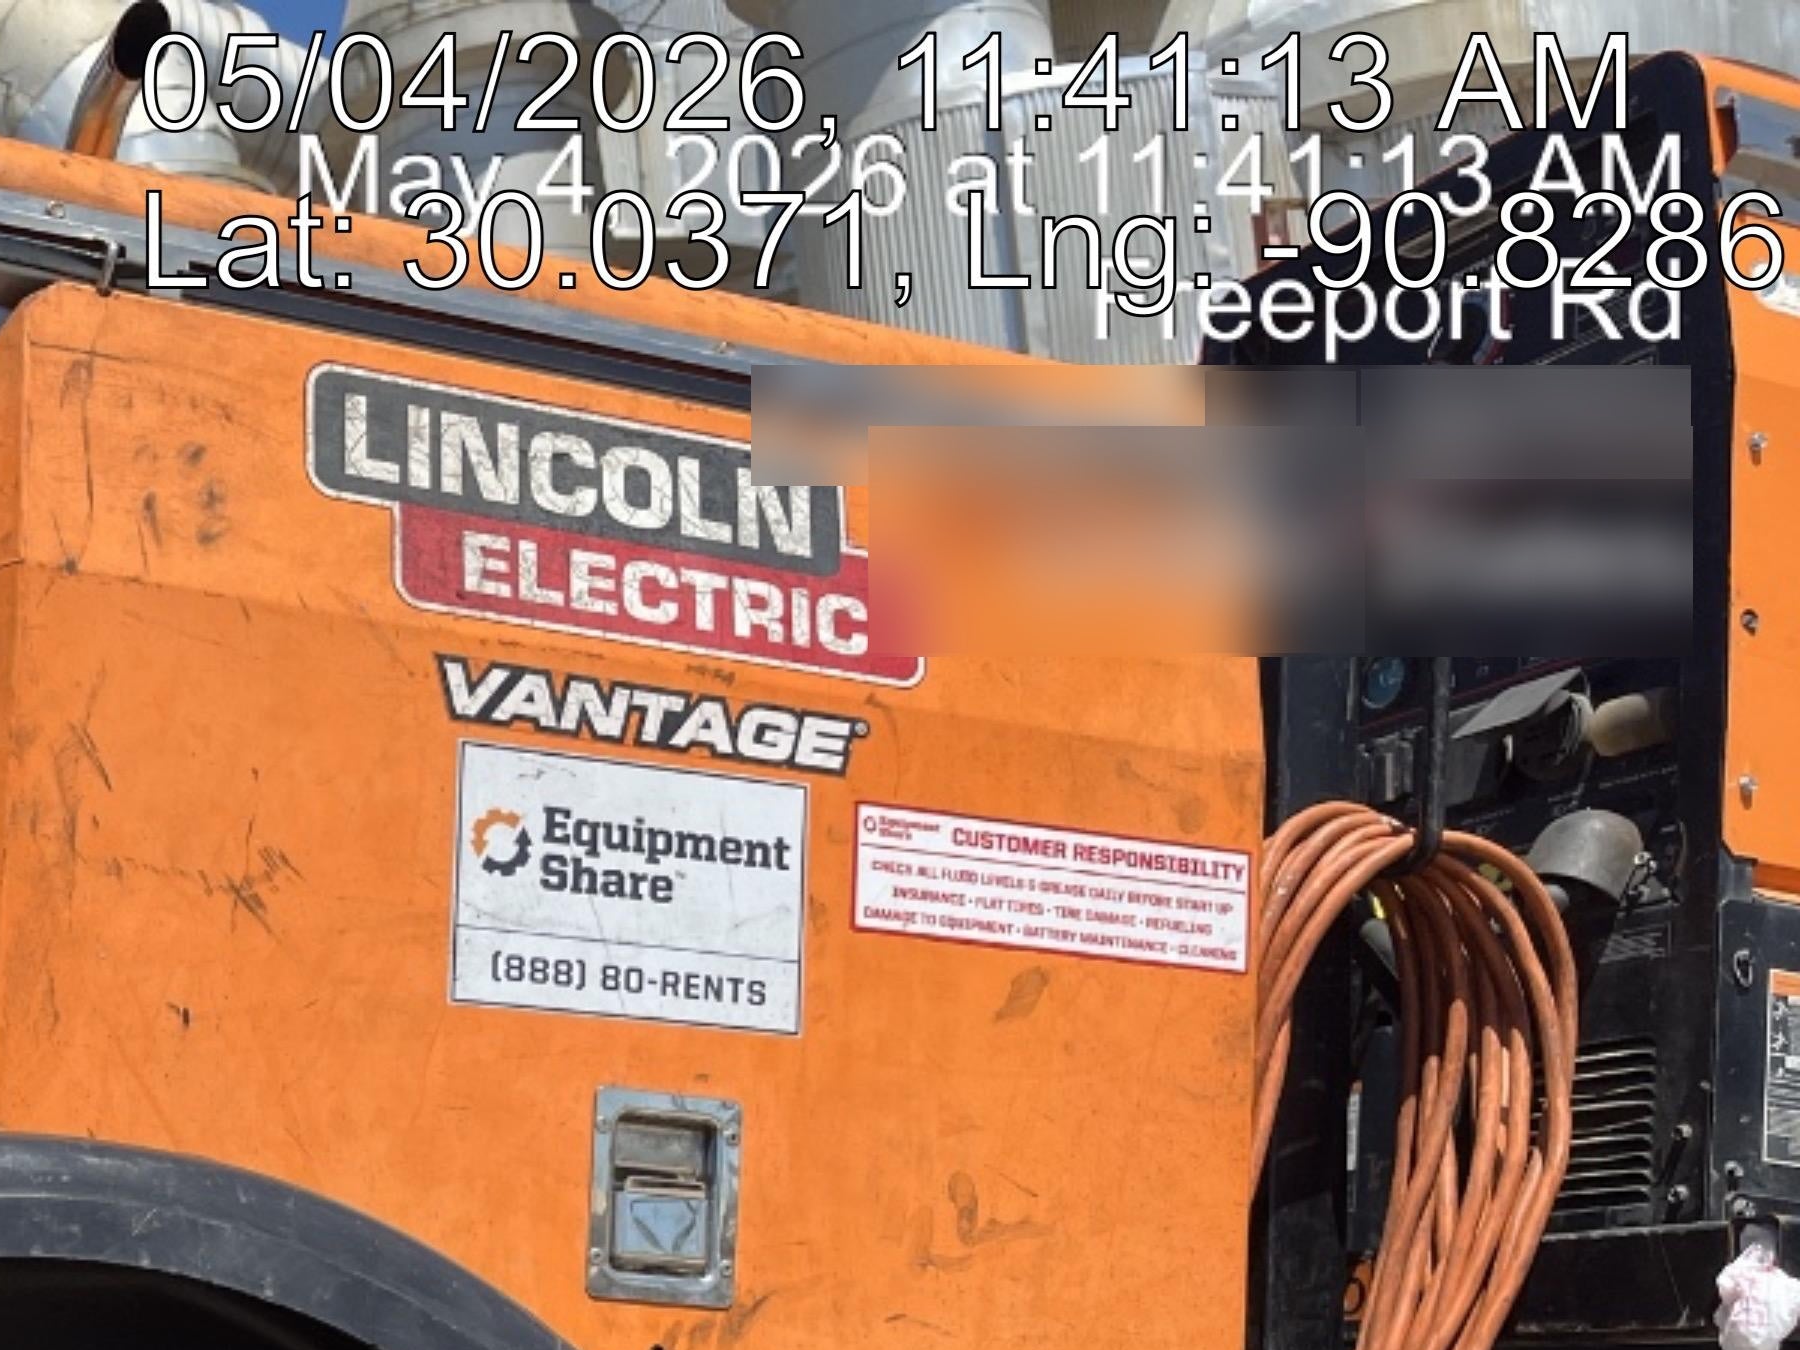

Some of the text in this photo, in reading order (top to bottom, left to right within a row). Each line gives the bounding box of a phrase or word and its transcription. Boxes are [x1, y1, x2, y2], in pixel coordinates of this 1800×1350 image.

[343, 392, 813, 560] LINCOLN
[461, 528, 869, 657] ELECTRIC
[542, 805, 791, 871] Equipment
[951, 827, 1245, 881] CUSTOMER RESPONSIBILITY
[540, 854, 674, 904] Share
[872, 860, 912, 876] CHECK
[1176, 897, 1213, 913] START
[892, 886, 967, 906] INSURANCE
[863, 905, 917, 925] DAMAGE
[939, 914, 1014, 935] EQUIPMENT
[491, 951, 767, 1007] (888) 80-RENTS
